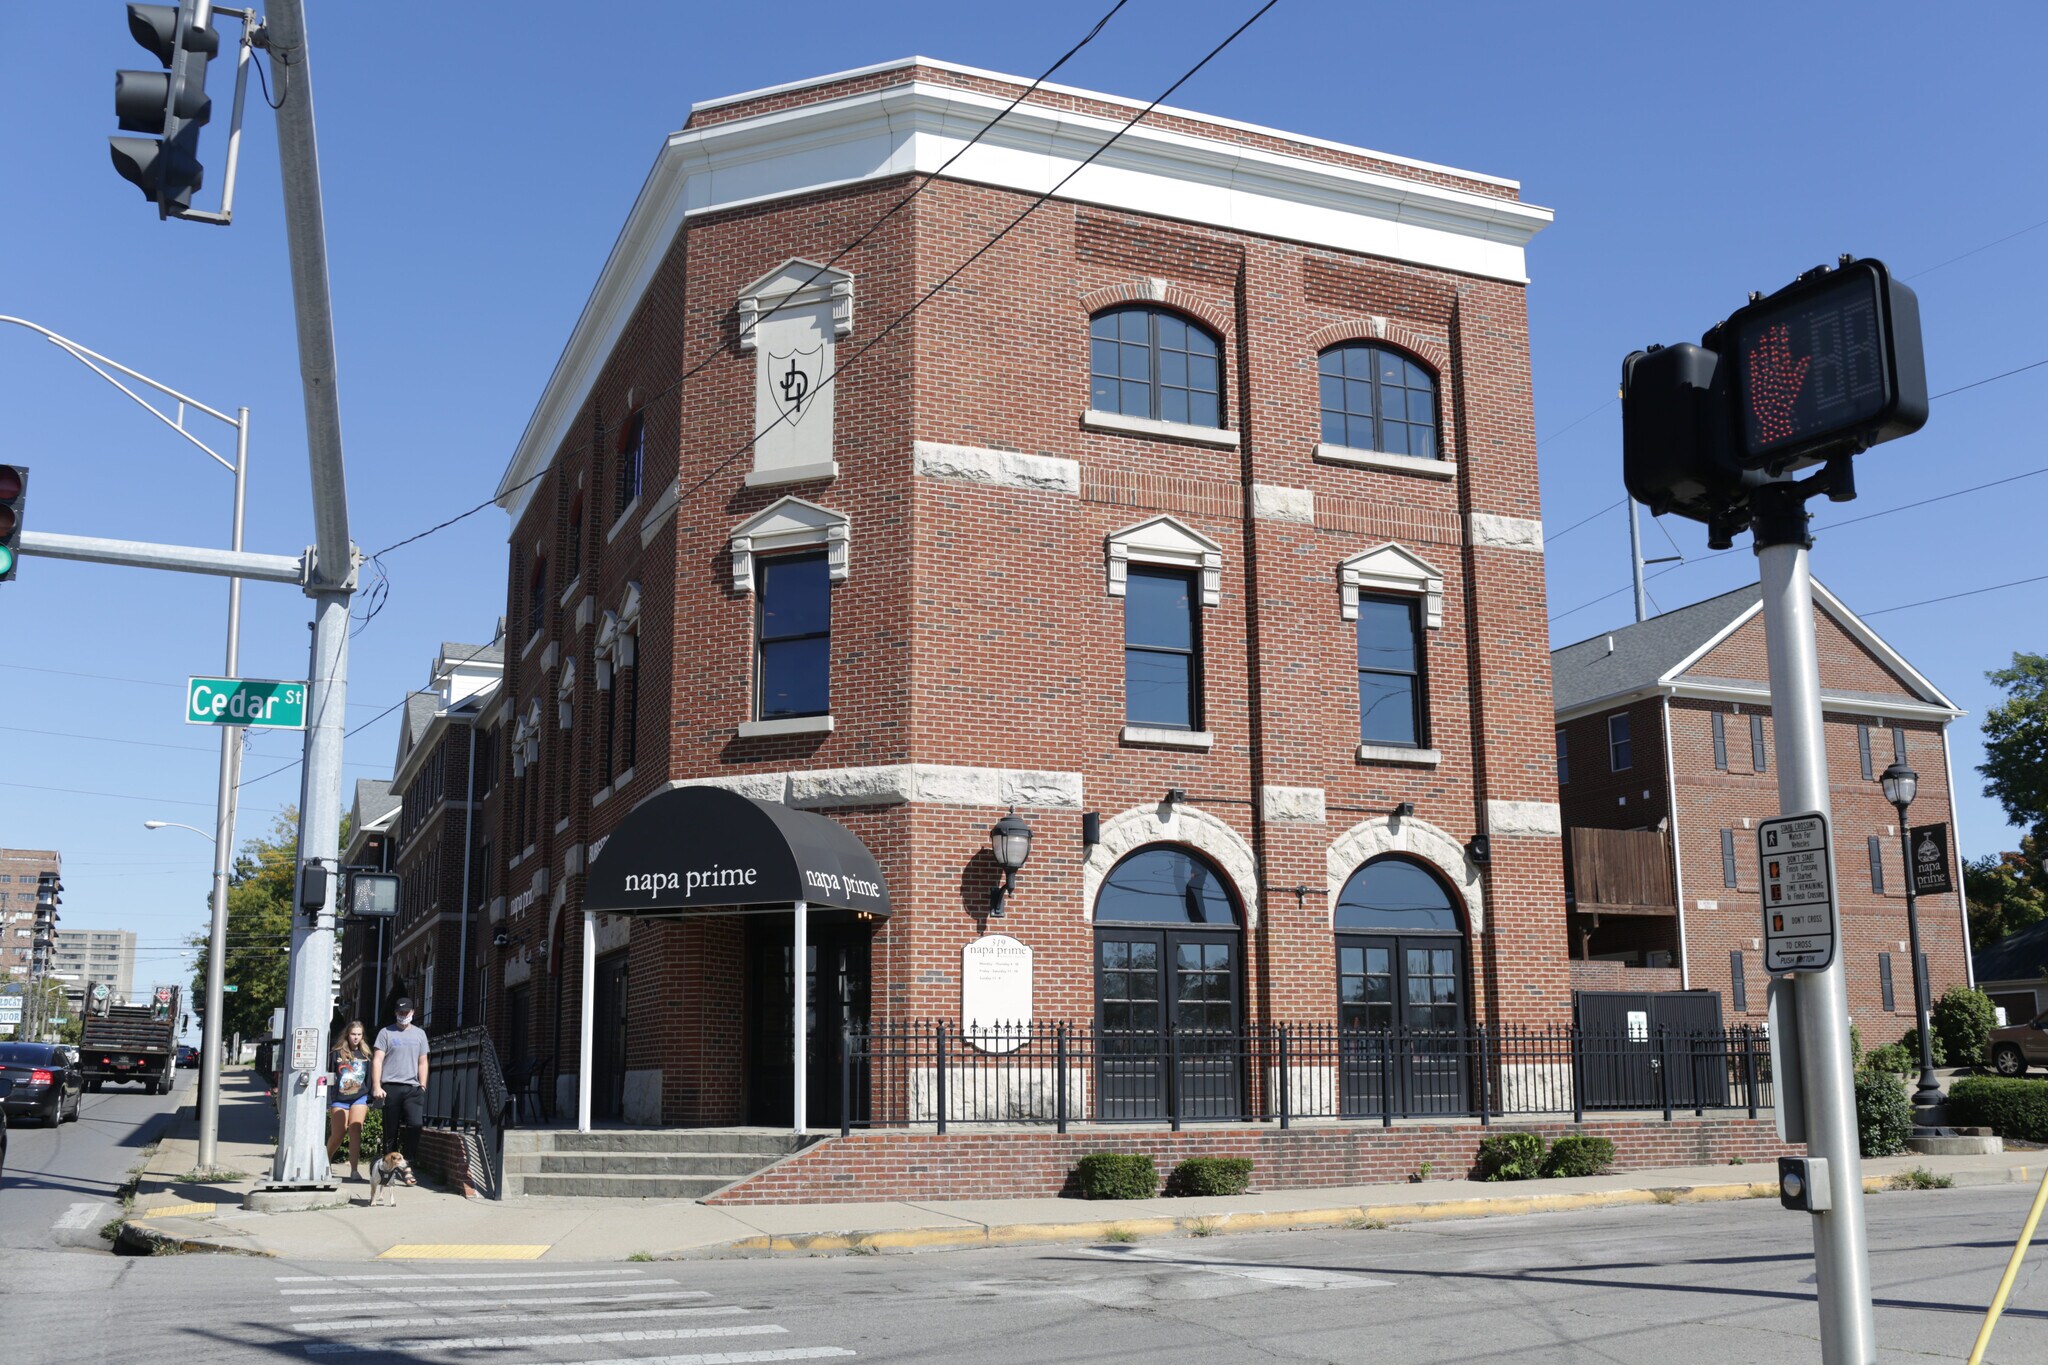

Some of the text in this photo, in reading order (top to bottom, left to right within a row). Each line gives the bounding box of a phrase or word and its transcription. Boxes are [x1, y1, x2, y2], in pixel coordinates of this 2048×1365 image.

[192, 685, 302, 719] Cedar St
[1787, 853, 1814, 863] DON'T START
[1786, 864, 1818, 873] Finish Crossing
[1918, 862, 1941, 875] napa
[1797, 872, 1812, 880] Started
[1917, 872, 1946, 889] prime
[625, 864, 757, 899] napa prime
[806, 869, 881, 899] napa prime
[1786, 882, 1824, 892] TIME REMAINING
[1793, 892, 1806, 900] Finish
[1807, 891, 1825, 900] Crossing
[1791, 915, 1823, 924] DON'T CROSS
[992, 938, 1006, 946] 319
[1786, 940, 1812, 949] TO CROSS
[970, 946, 1027, 958] napa prime
[1780, 957, 1794, 965] PUSH
